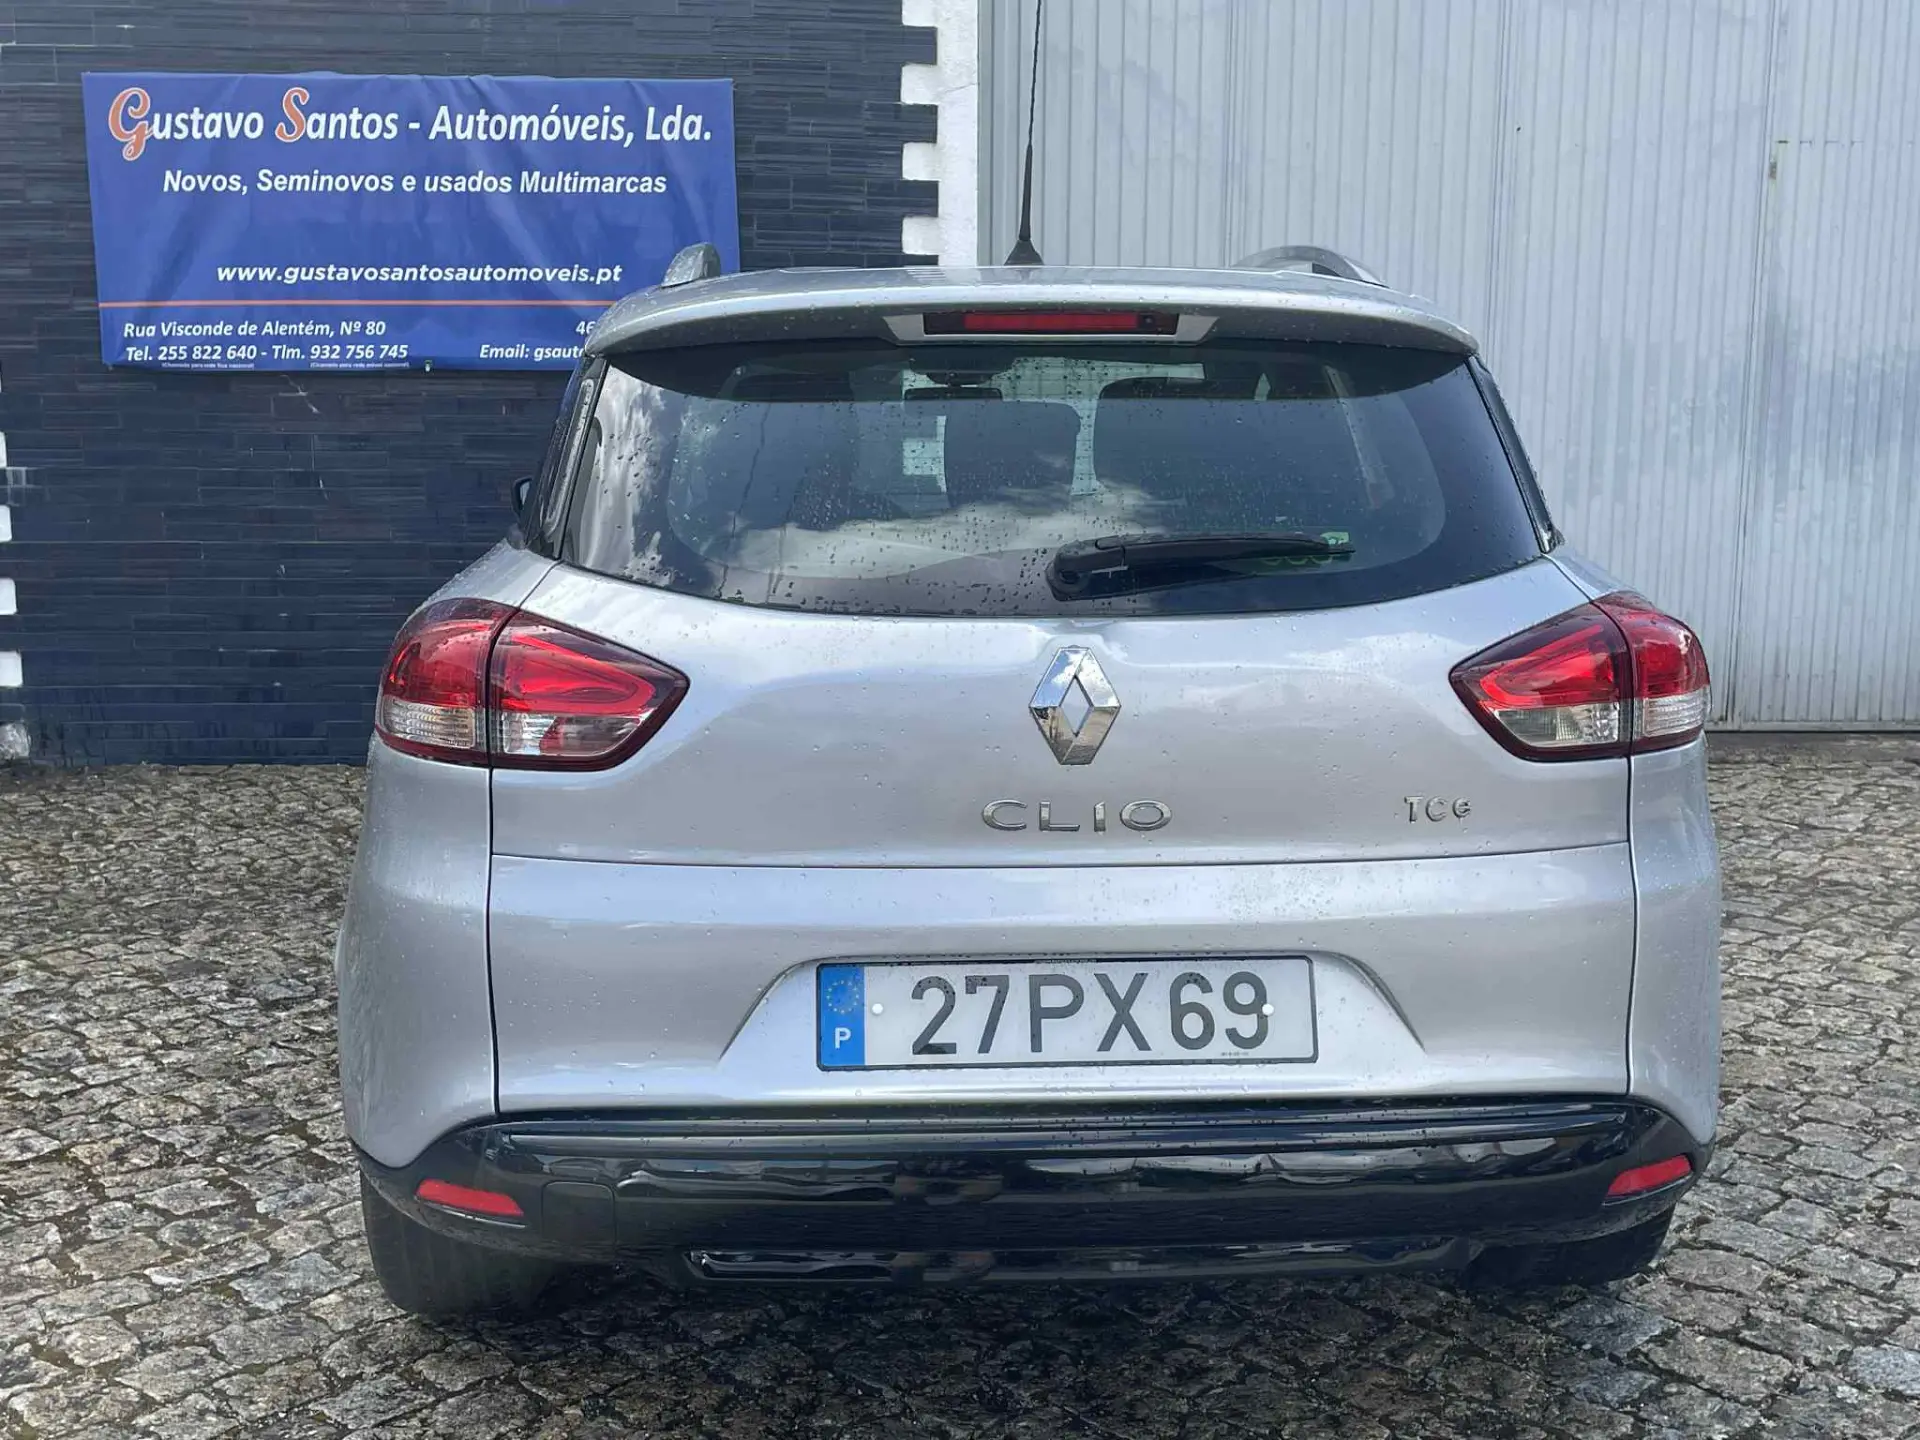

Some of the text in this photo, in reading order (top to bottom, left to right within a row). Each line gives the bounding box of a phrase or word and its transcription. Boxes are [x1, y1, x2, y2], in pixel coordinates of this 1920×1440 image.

[108, 87, 264, 162] Gustavo
[274, 86, 399, 143] Santos
[428, 103, 634, 148] Automóveis,
[645, 104, 711, 141] Lda.
[163, 168, 667, 196] Novos, Seminovos e usados Multimarcas
[217, 264, 623, 285] www.gustavosantosautomoveis.pt
[123, 320, 386, 339] Rua Visconde de Alentém, Nº 80
[126, 345, 153, 361] Tel.
[157, 345, 188, 361] 255
[192, 345, 222, 360] 822
[226, 345, 257, 360] 640
[272, 344, 305, 359] Tlm.
[310, 344, 341, 359] 932
[345, 344, 375, 359] 756
[379, 344, 409, 359] 745
[479, 343, 530, 358] Email:
[982, 799, 1172, 831] CLIO
[1403, 795, 1472, 824] TCe
[834, 1027, 852, 1049] P
